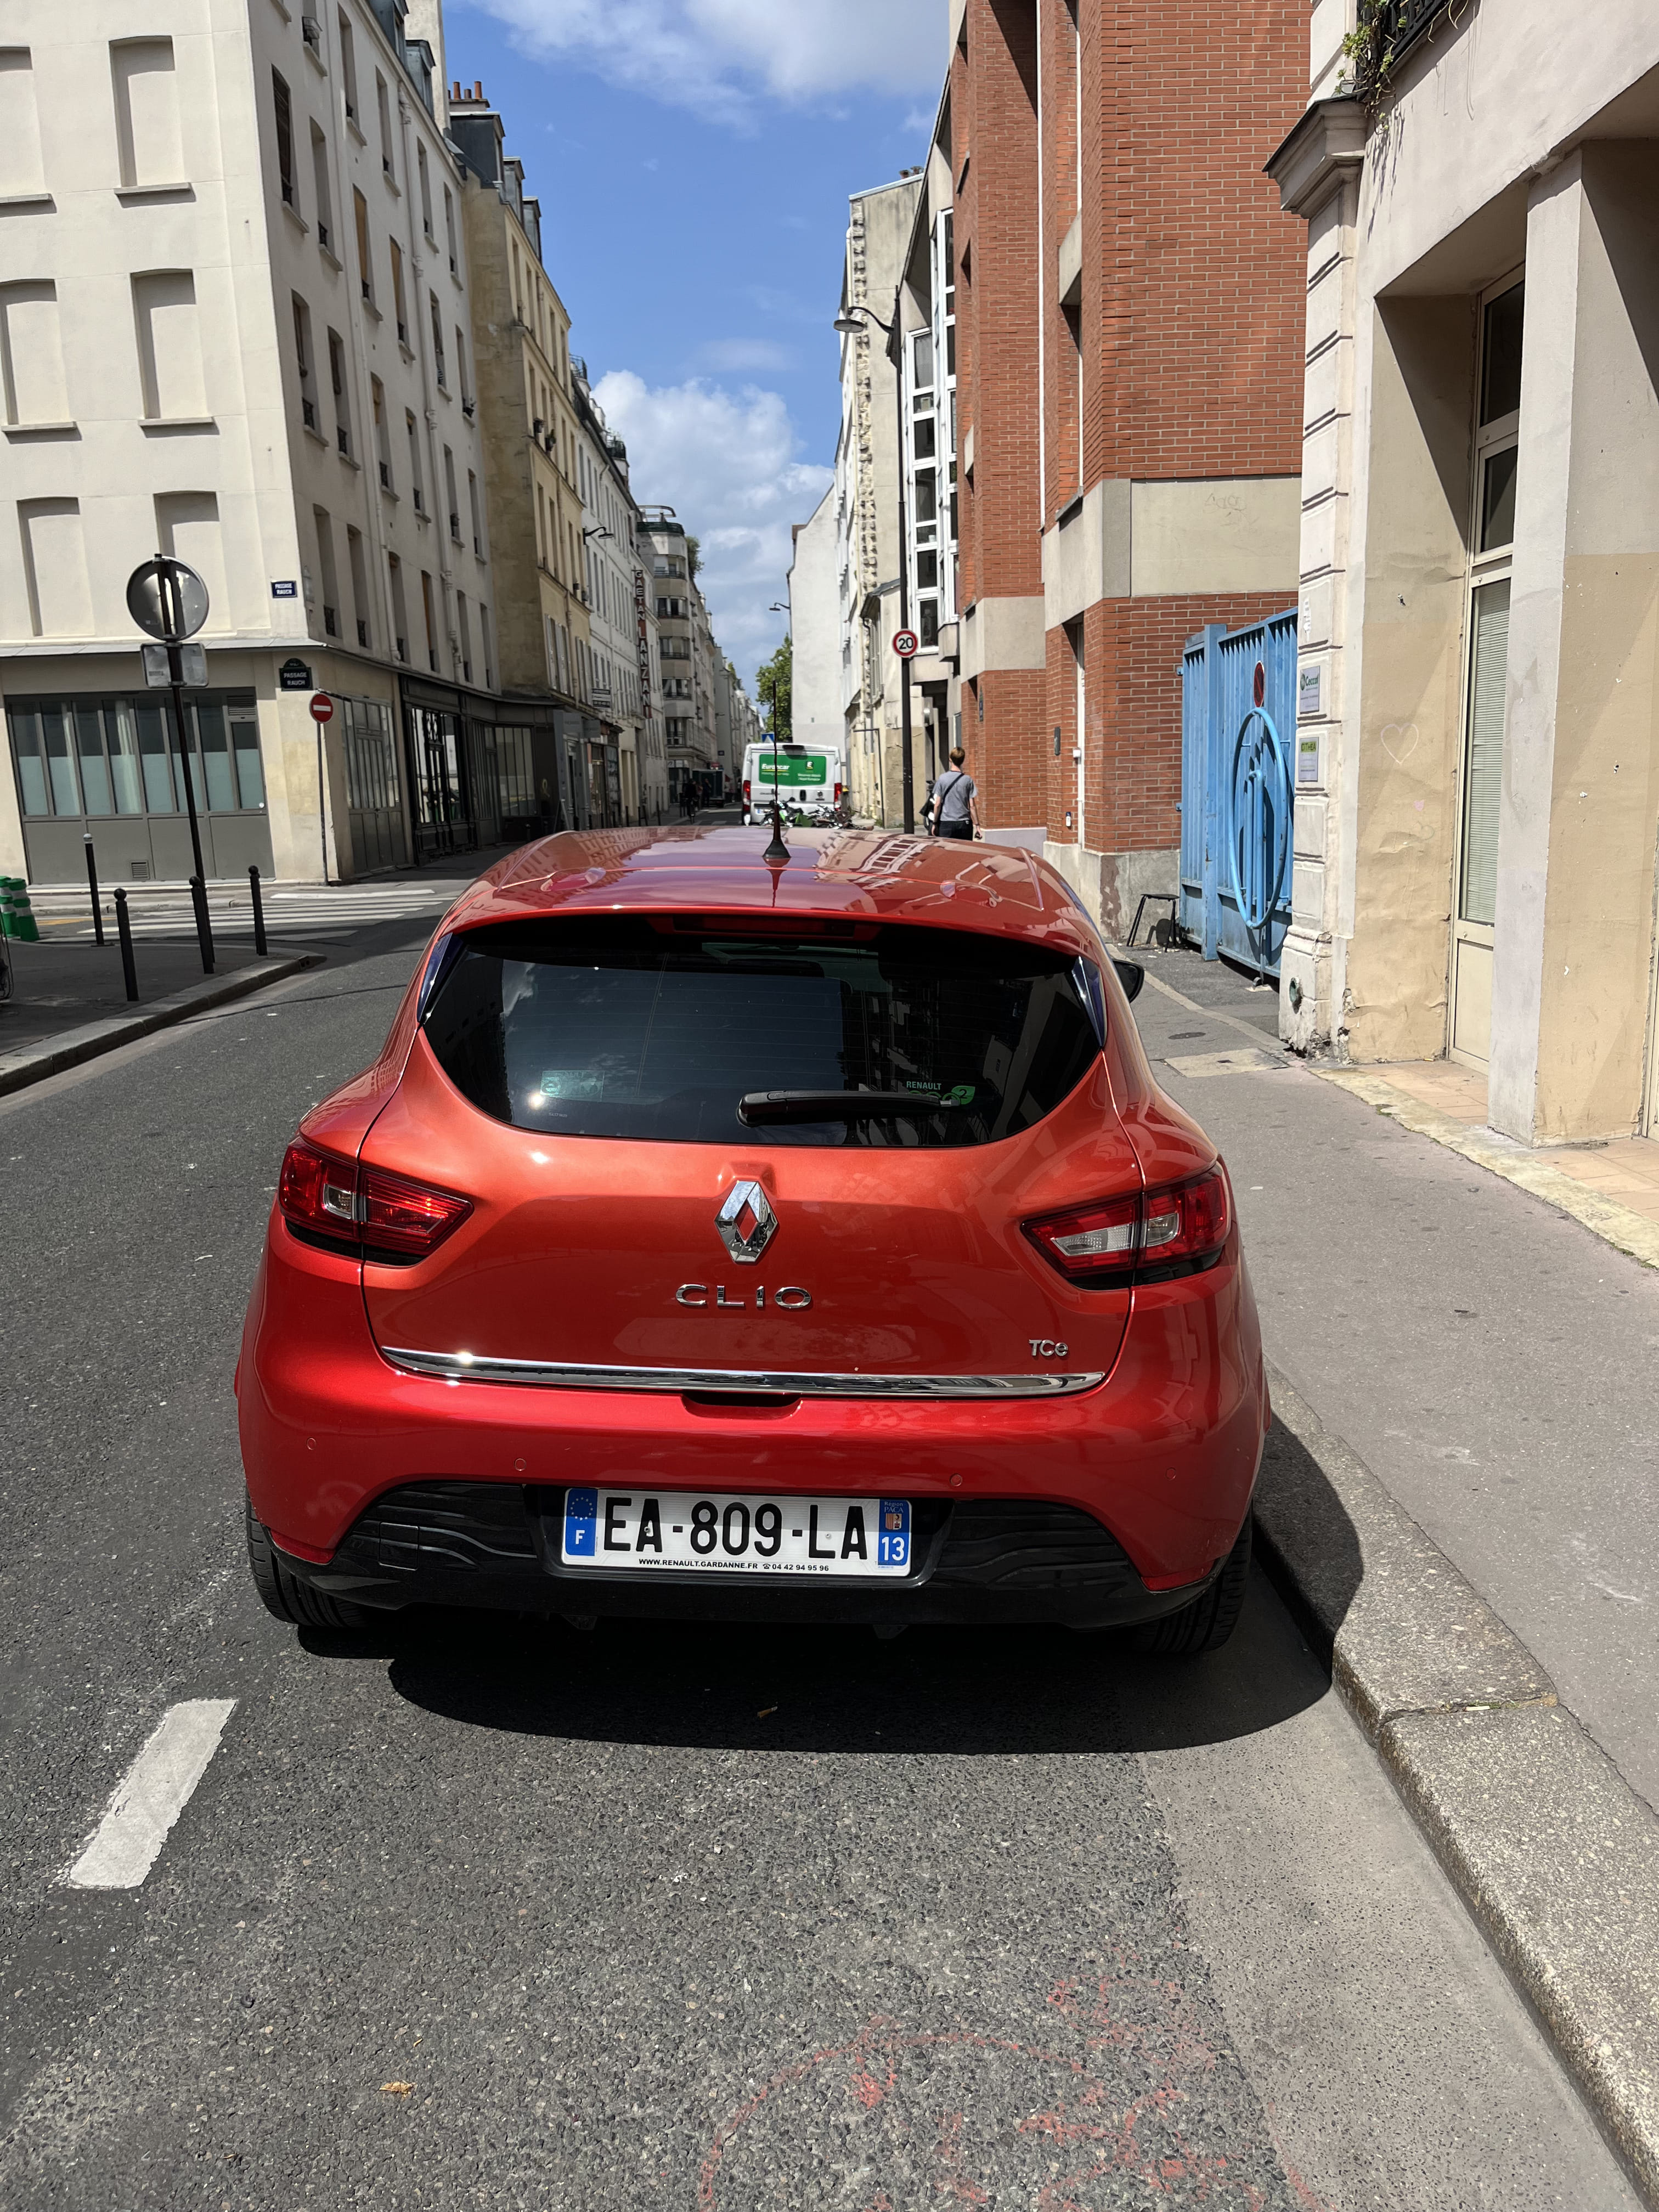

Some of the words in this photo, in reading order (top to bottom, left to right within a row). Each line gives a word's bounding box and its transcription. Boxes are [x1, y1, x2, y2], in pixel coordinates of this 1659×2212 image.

[899, 637, 913, 650] 20
[639, 627, 652, 719] LANZANI
[906, 1081, 942, 1090] RENAULT
[675, 1284, 811, 1309] CLIO
[1029, 1339, 1068, 1356] TCe
[575, 1530, 585, 1544] F
[603, 1497, 868, 1560] EA-809-LA
[882, 1536, 905, 1561] 13
[639, 1559, 758, 1569] WWW.RENAULT.GARDANNE.FR
